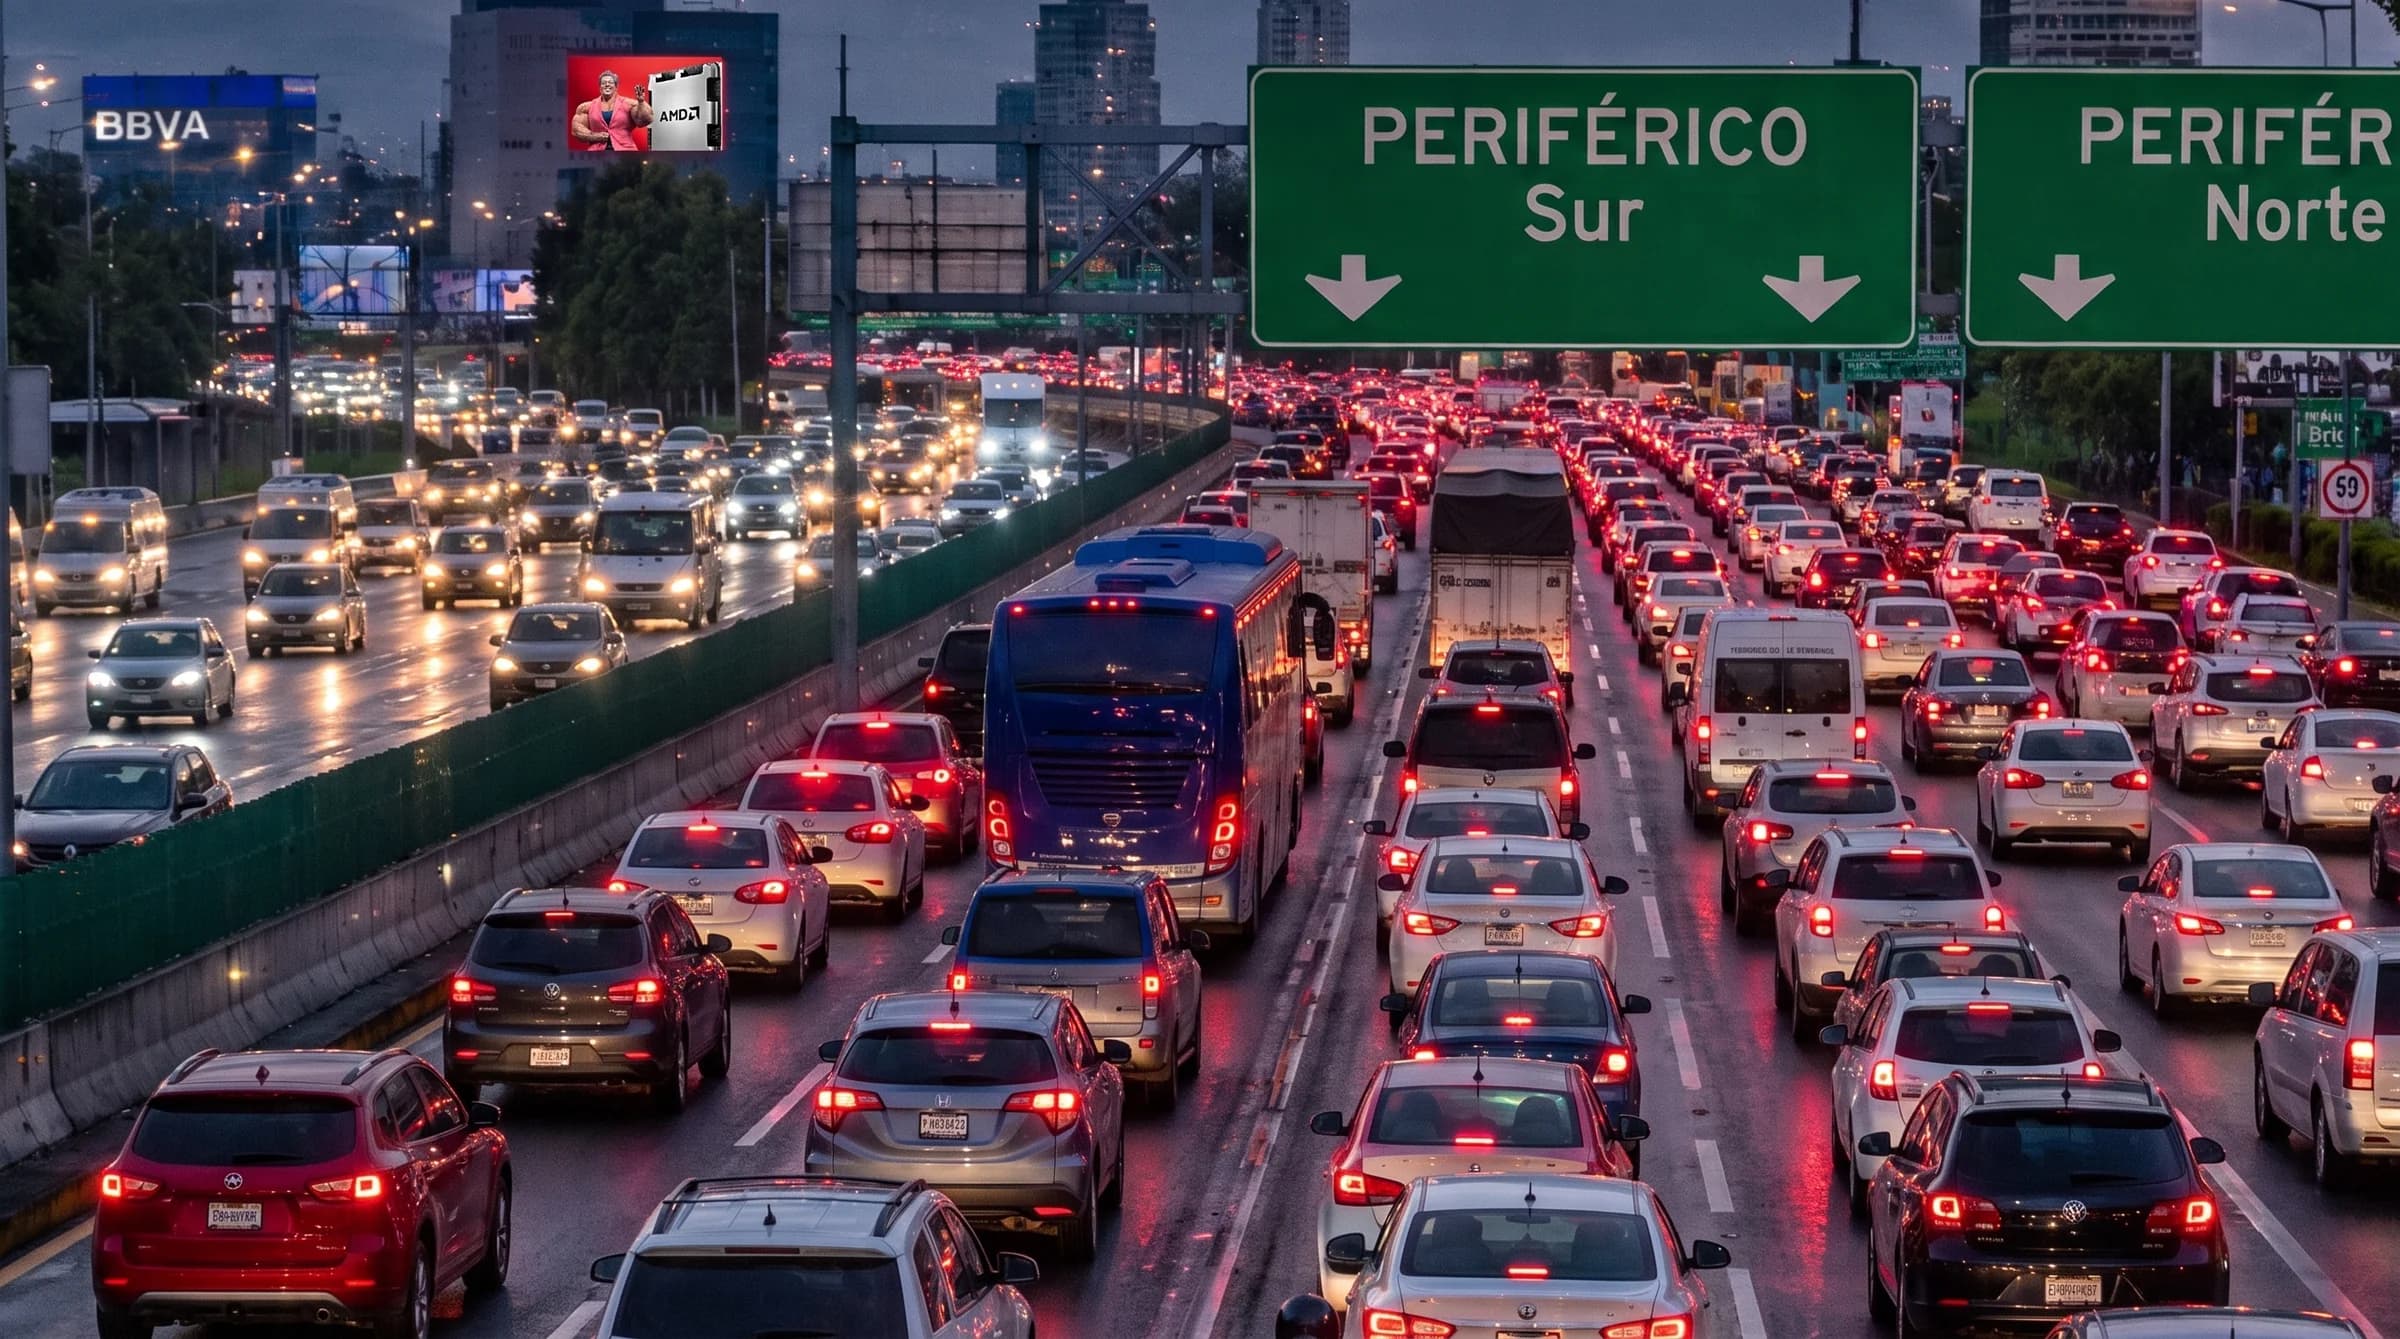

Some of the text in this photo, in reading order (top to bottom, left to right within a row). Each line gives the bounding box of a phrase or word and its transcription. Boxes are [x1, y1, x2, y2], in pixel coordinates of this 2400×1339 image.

[95, 110, 209, 140] BBVA
[659, 107, 688, 122] AMD
[1364, 92, 1807, 166] PERIFÉRICO
[2081, 92, 2392, 165] PERIFÉR
[1524, 183, 1644, 242] Sur
[2207, 184, 2386, 242] Norte
